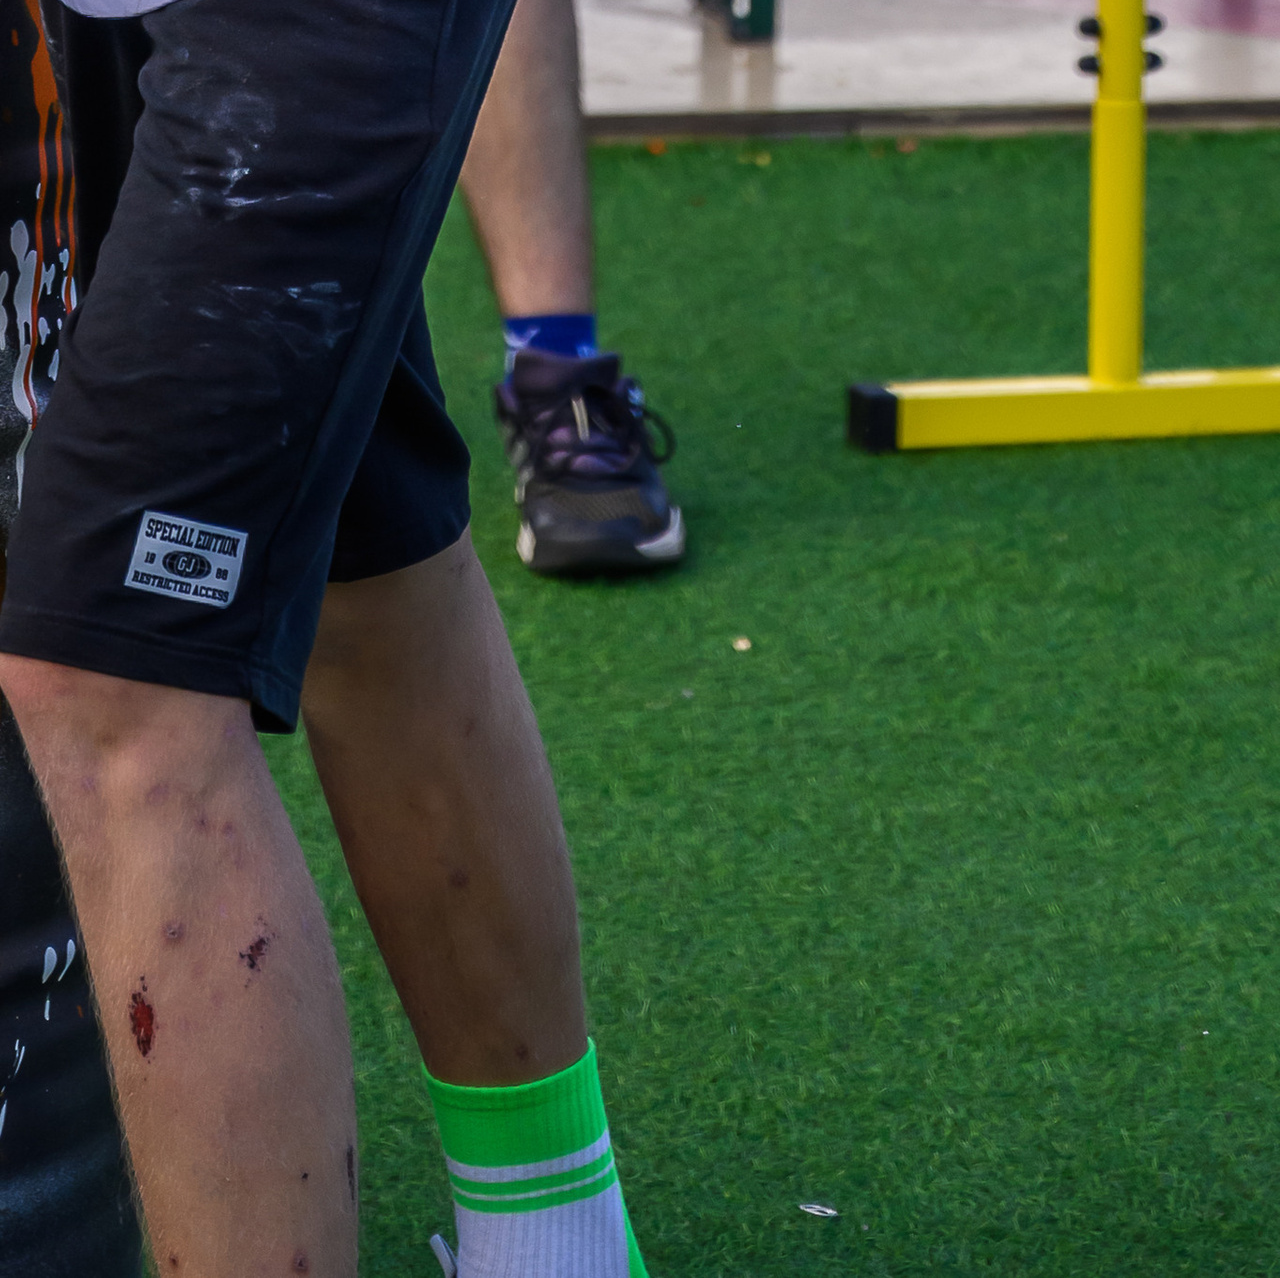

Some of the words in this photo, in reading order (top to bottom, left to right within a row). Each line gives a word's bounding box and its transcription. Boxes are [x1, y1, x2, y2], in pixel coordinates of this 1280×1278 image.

[146, 519, 194, 547] SPECIAL
[195, 531, 240, 557] EDITION
[178, 557, 196, 572] GJ
[133, 571, 192, 594] RESTRICTED
[193, 586, 229, 602] ACCESS
